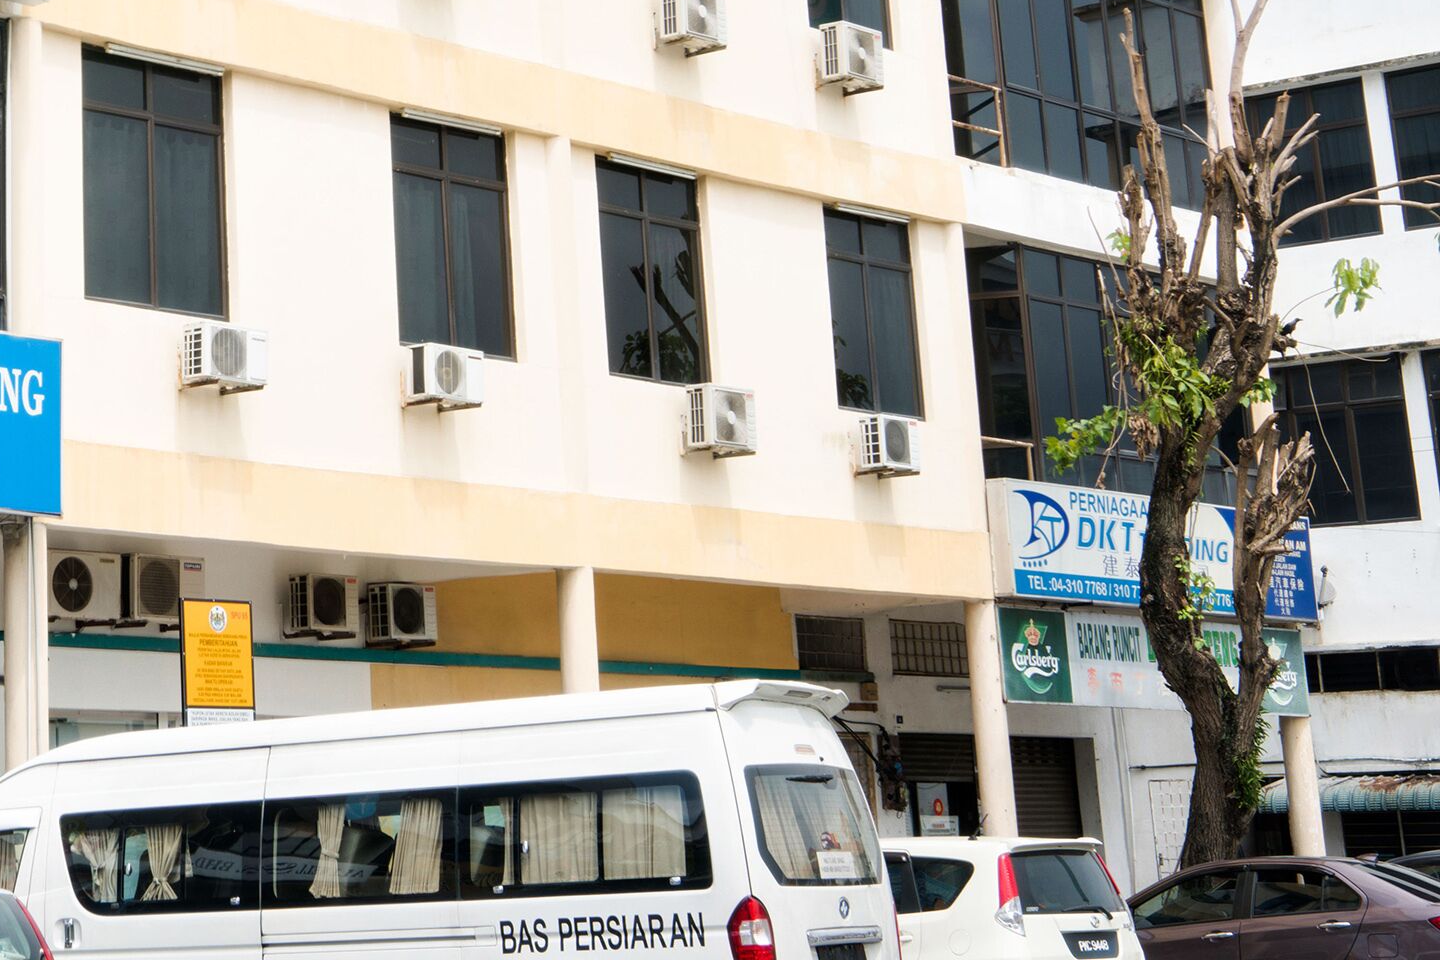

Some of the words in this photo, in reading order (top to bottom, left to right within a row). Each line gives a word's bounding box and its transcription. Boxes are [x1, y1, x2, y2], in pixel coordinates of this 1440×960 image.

[1069, 491, 1149, 519] PERNIAGAA
[1076, 516, 1135, 552] DKT
[1027, 574, 1047, 590] TEL
[1012, 643, 1060, 675] Carlsberg
[1077, 623, 1111, 660] BARANG
[1112, 625, 1141, 662] RUNCIT
[499, 918, 549, 954] BAS
[558, 912, 706, 952] PERSIARAN
